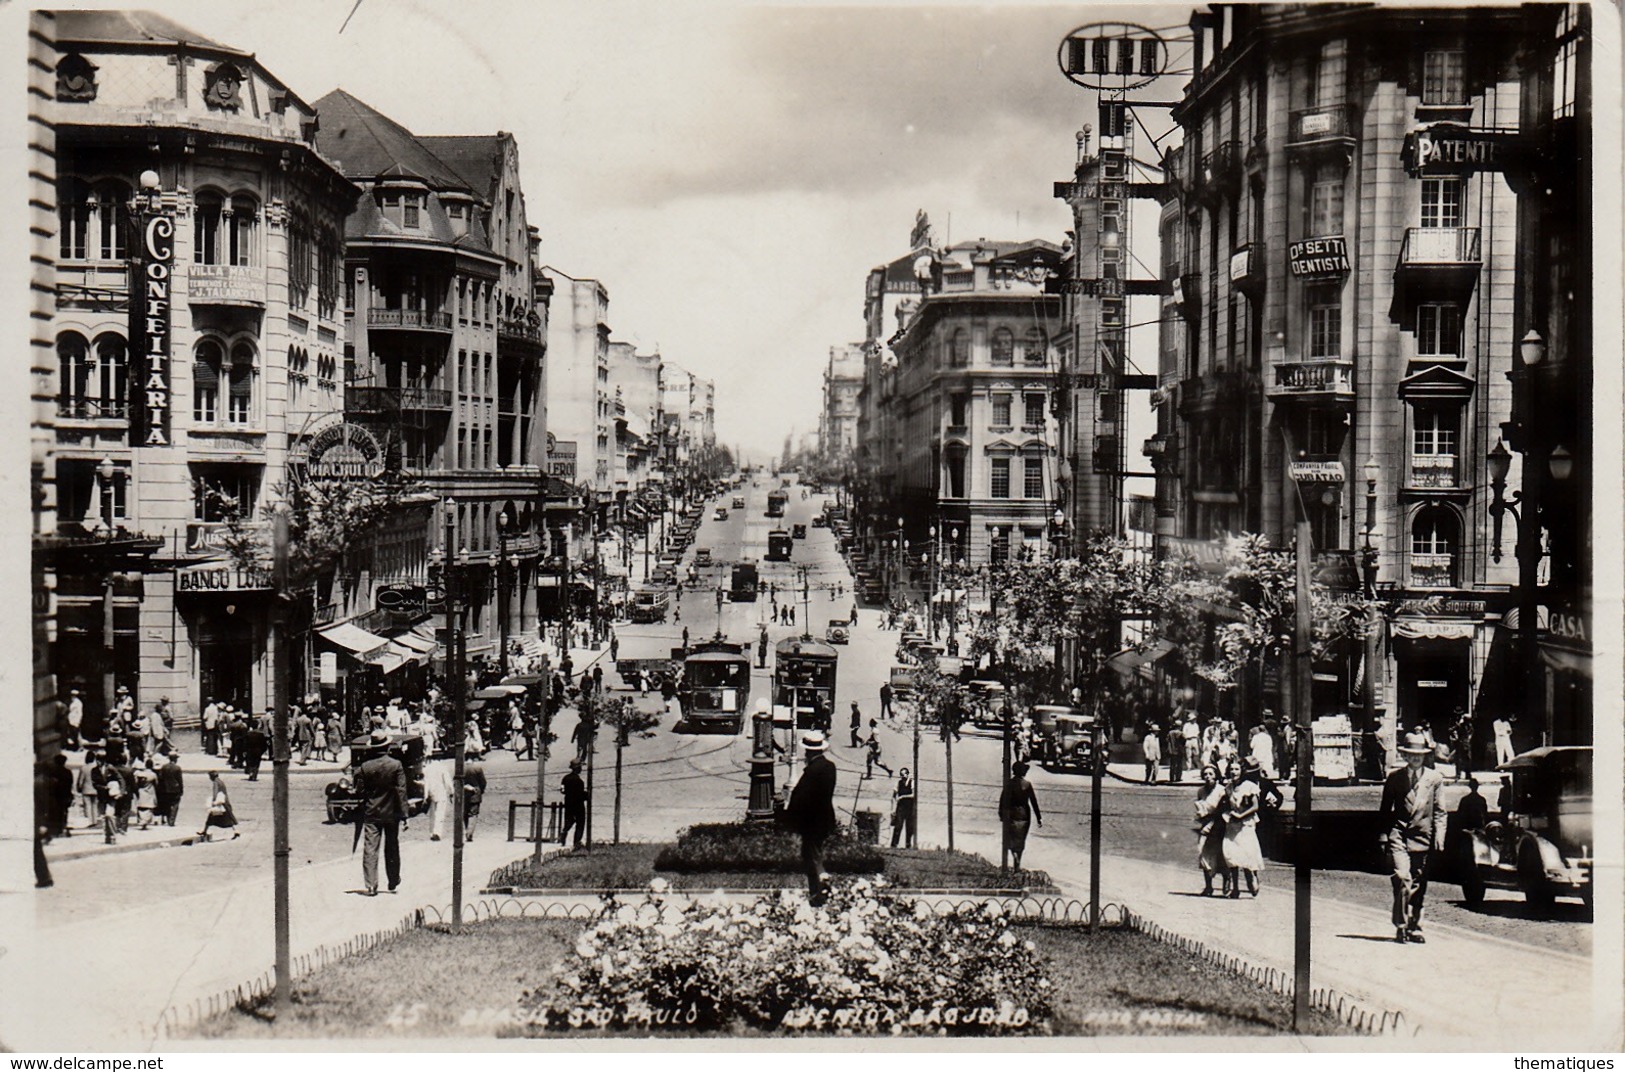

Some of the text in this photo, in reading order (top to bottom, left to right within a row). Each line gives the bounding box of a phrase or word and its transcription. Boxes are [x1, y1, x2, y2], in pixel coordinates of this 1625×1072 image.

[1305, 240, 1345, 255] SETTI
[189, 266, 224, 277] VILLA
[1291, 256, 1349, 275] DENTISTA
[146, 217, 172, 445] CONFEITARIA
[180, 567, 230, 591] BANCO
[1445, 601, 1485, 613] SIQUEIRA
[1550, 613, 1586, 640] CASA
